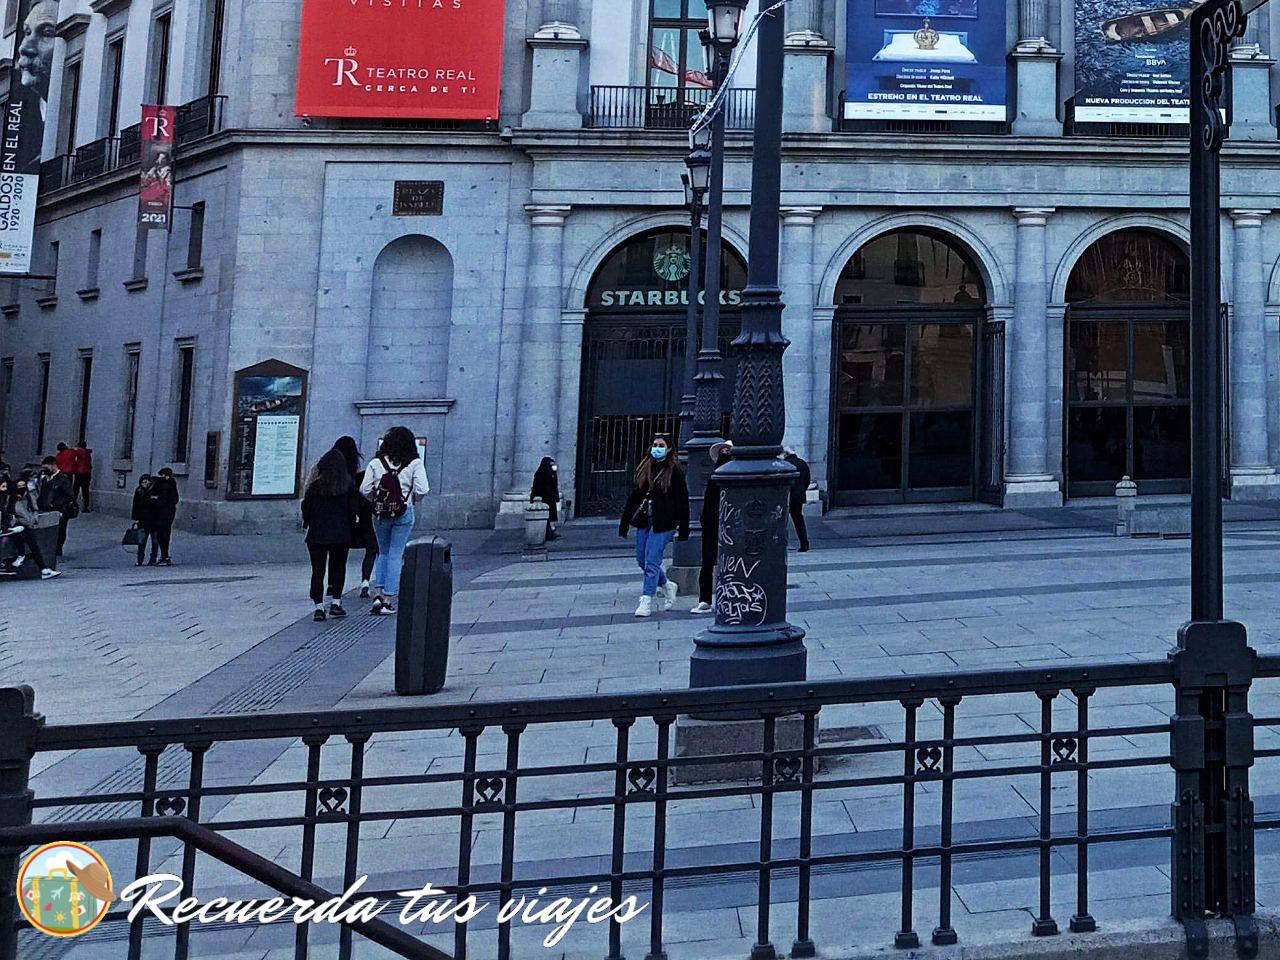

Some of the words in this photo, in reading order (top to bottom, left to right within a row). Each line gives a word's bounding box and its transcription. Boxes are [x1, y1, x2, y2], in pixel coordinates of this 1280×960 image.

[366, 67, 429, 79] TEATRO
[435, 69, 476, 81] REAL
[365, 84, 418, 93] CERCA
[461, 86, 476, 94] TI
[8, 101, 23, 131] REAL
[6, 135, 19, 149] EL
[3, 153, 15, 171] EN
[9, 208, 20, 232] 1920
[15, 175, 25, 198] 2020
[141, 213, 166, 223] 2021
